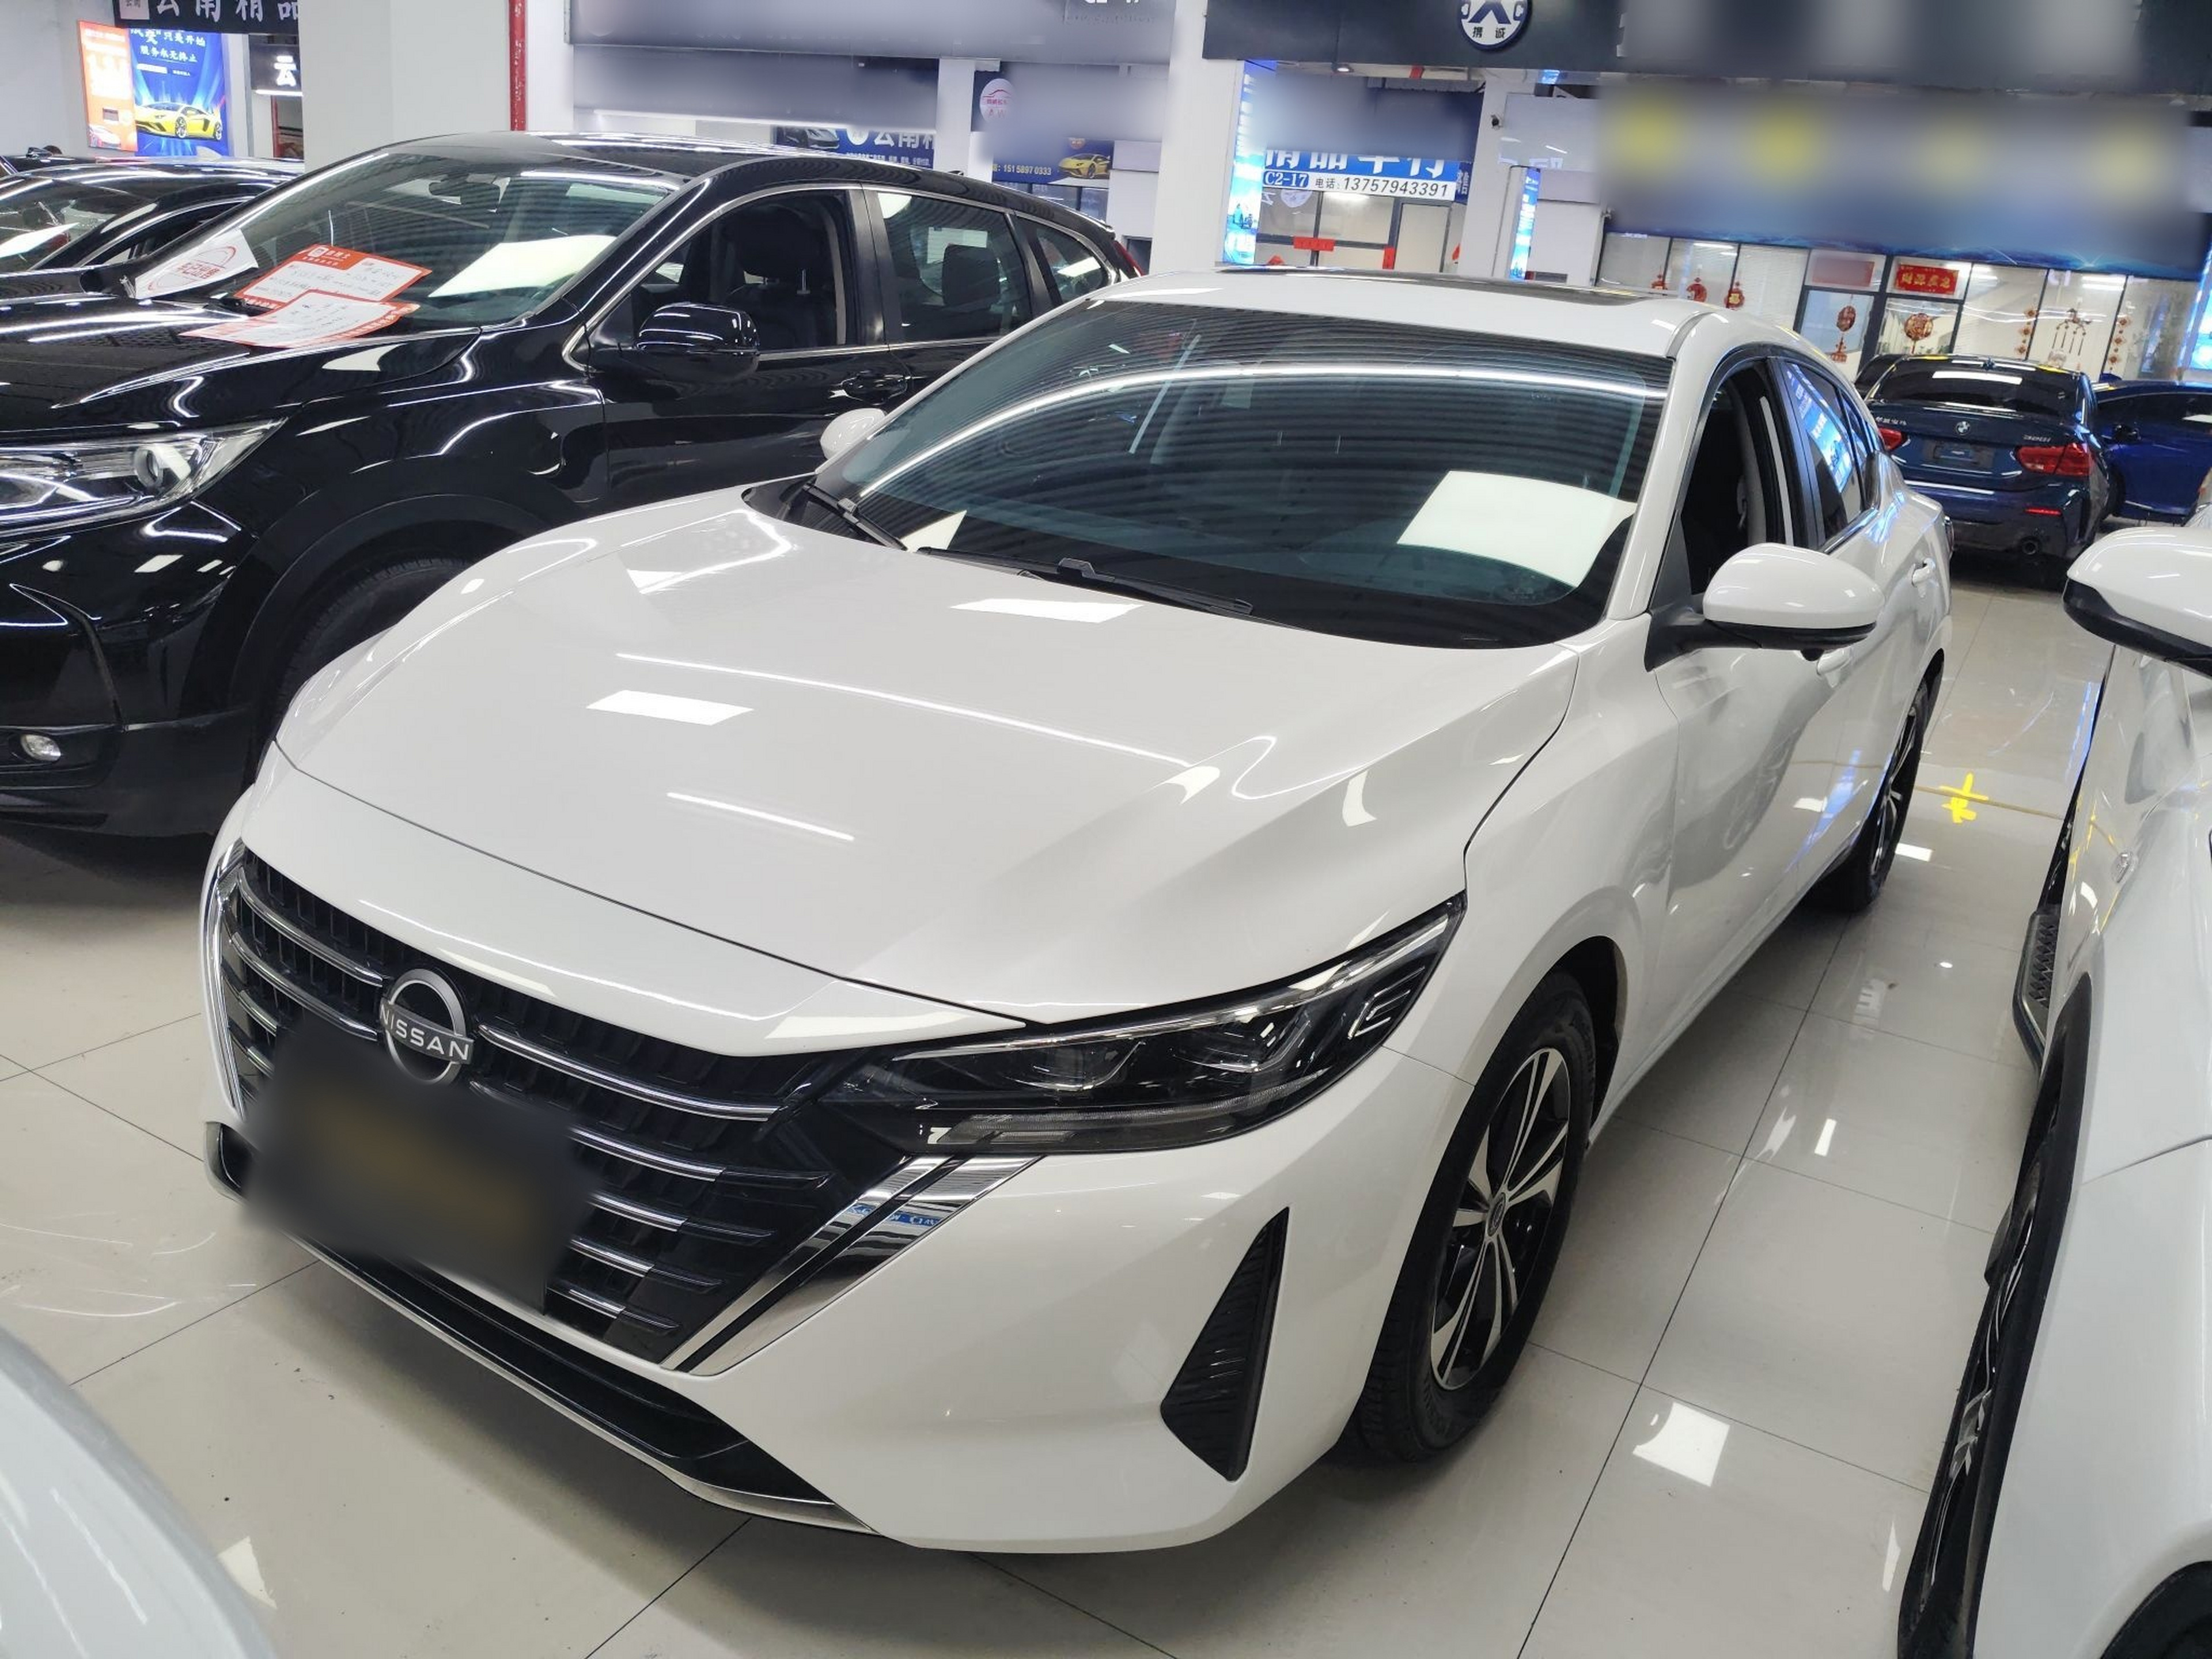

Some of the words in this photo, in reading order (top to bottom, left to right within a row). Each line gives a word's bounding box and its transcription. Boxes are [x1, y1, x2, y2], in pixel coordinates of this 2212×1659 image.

[274, 55, 297, 87] 云
[1264, 172, 1308, 187] C2-17
[1343, 177, 1448, 197] 13757943391
[380, 1004, 469, 1060] NISSAN
